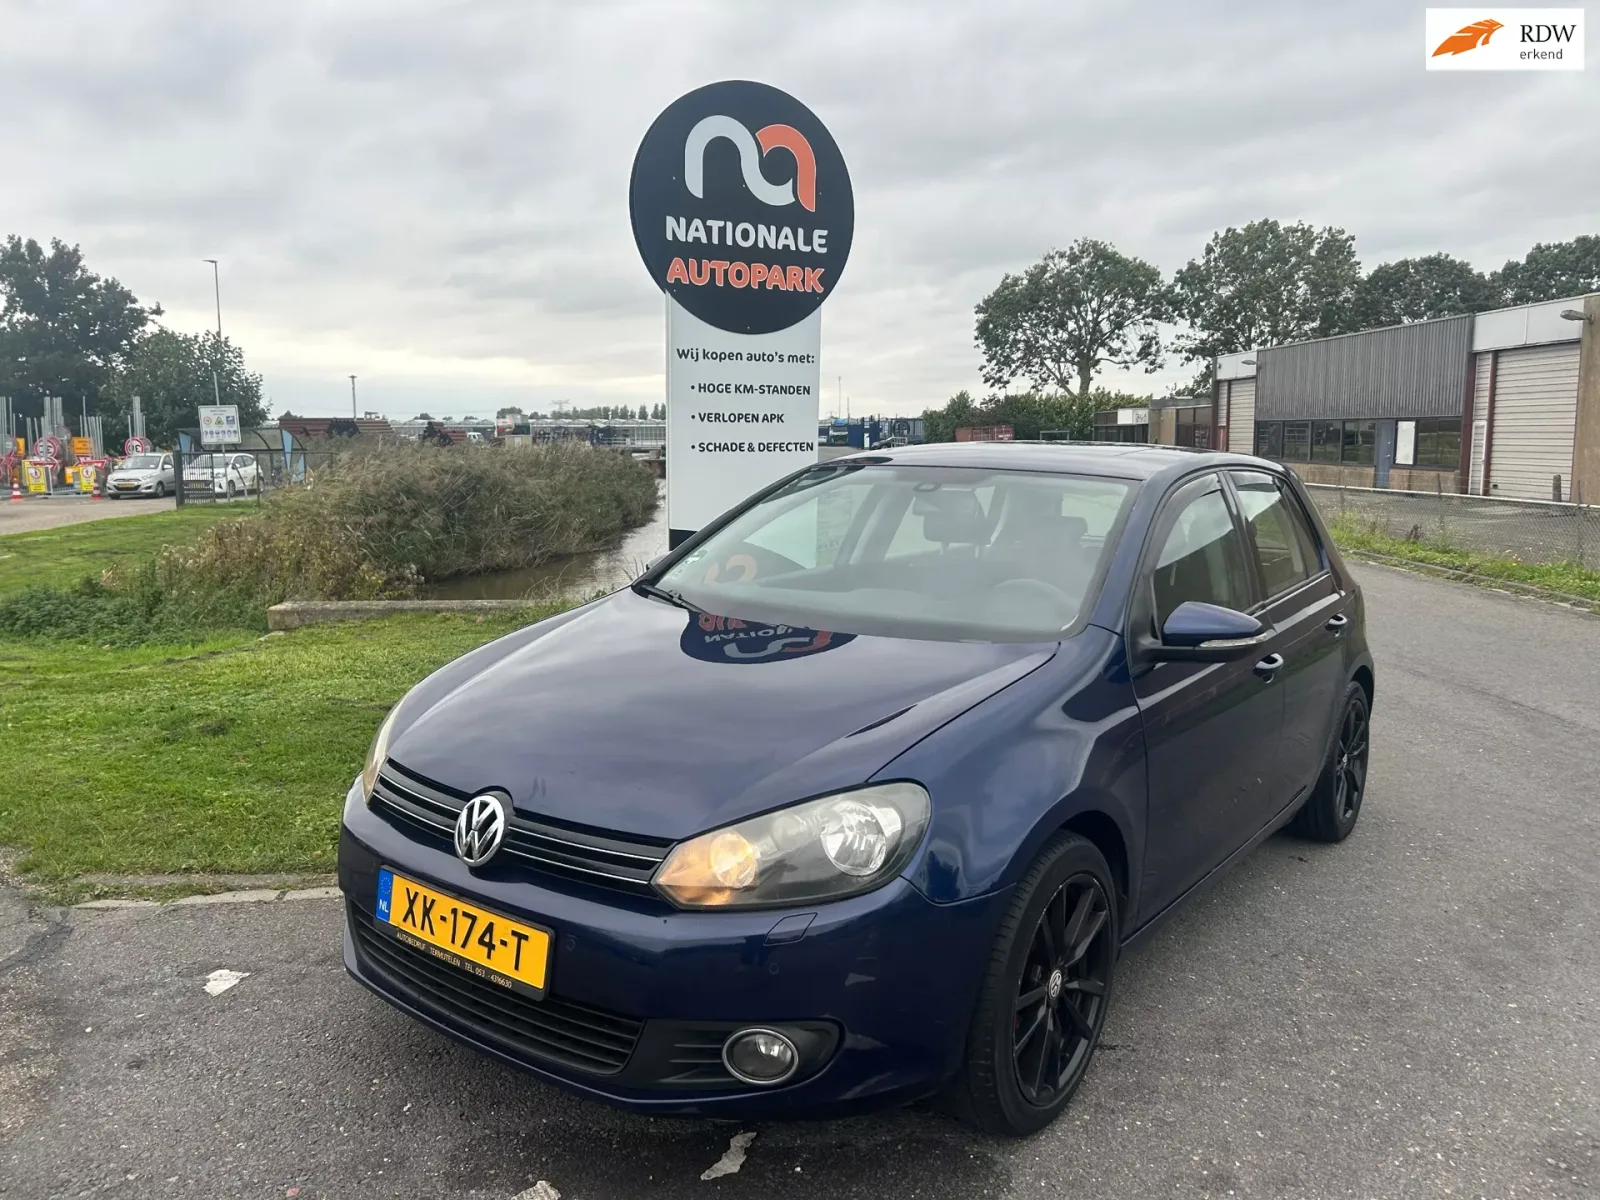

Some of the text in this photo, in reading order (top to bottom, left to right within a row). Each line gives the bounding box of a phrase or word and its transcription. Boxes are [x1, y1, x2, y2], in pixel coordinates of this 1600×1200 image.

[665, 215, 829, 254] NATIONALE
[666, 257, 825, 294] AUTOPARK
[676, 348, 815, 364] Wij kopen auto's met:
[698, 382, 811, 396] HOGE KM-STANDEN
[698, 412, 785, 424] VERLOPEN APK
[698, 441, 814, 453] SCHADE & DEFECTEN
[378, 898, 389, 914] NL
[402, 886, 530, 972] XK-174-T
